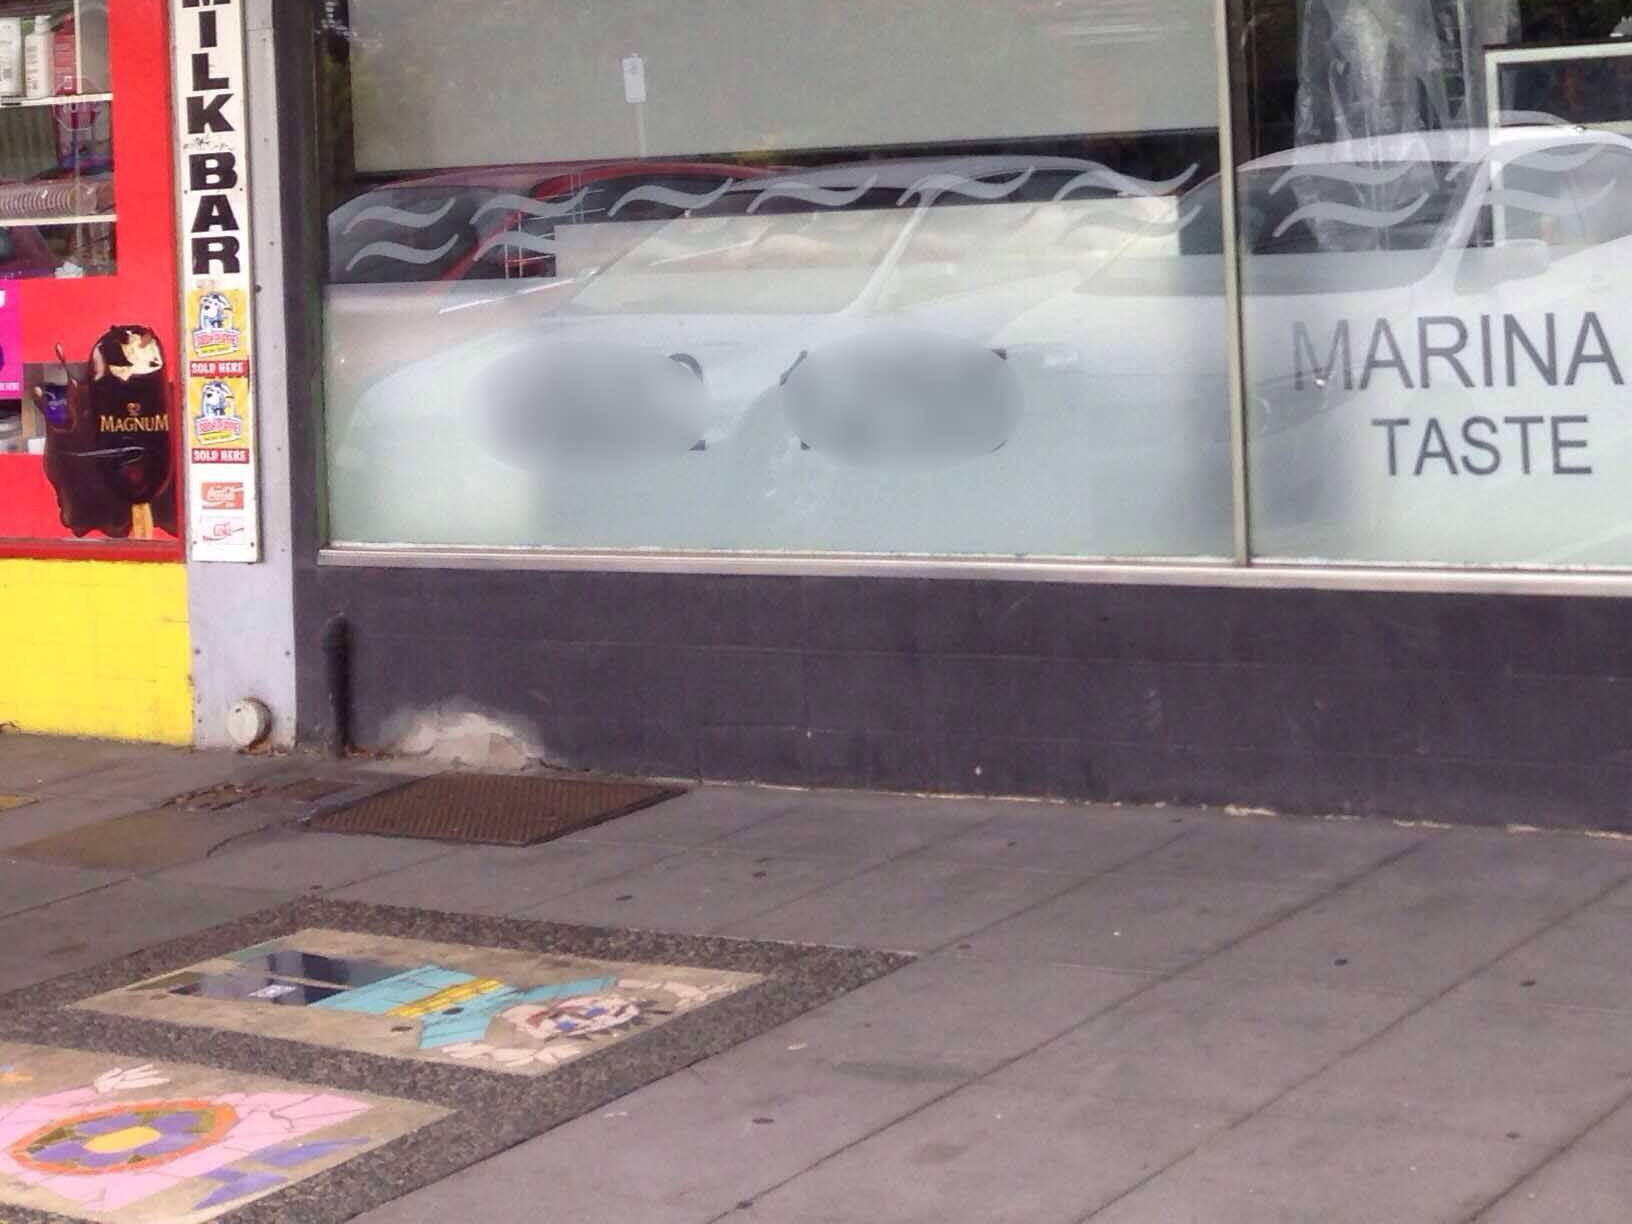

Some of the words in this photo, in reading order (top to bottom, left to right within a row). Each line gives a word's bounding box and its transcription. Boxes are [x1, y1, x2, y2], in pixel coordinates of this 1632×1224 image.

[189, 151, 240, 275] BAR
[1291, 311, 1625, 391] MARINA
[1371, 414, 1593, 477] TASTE
